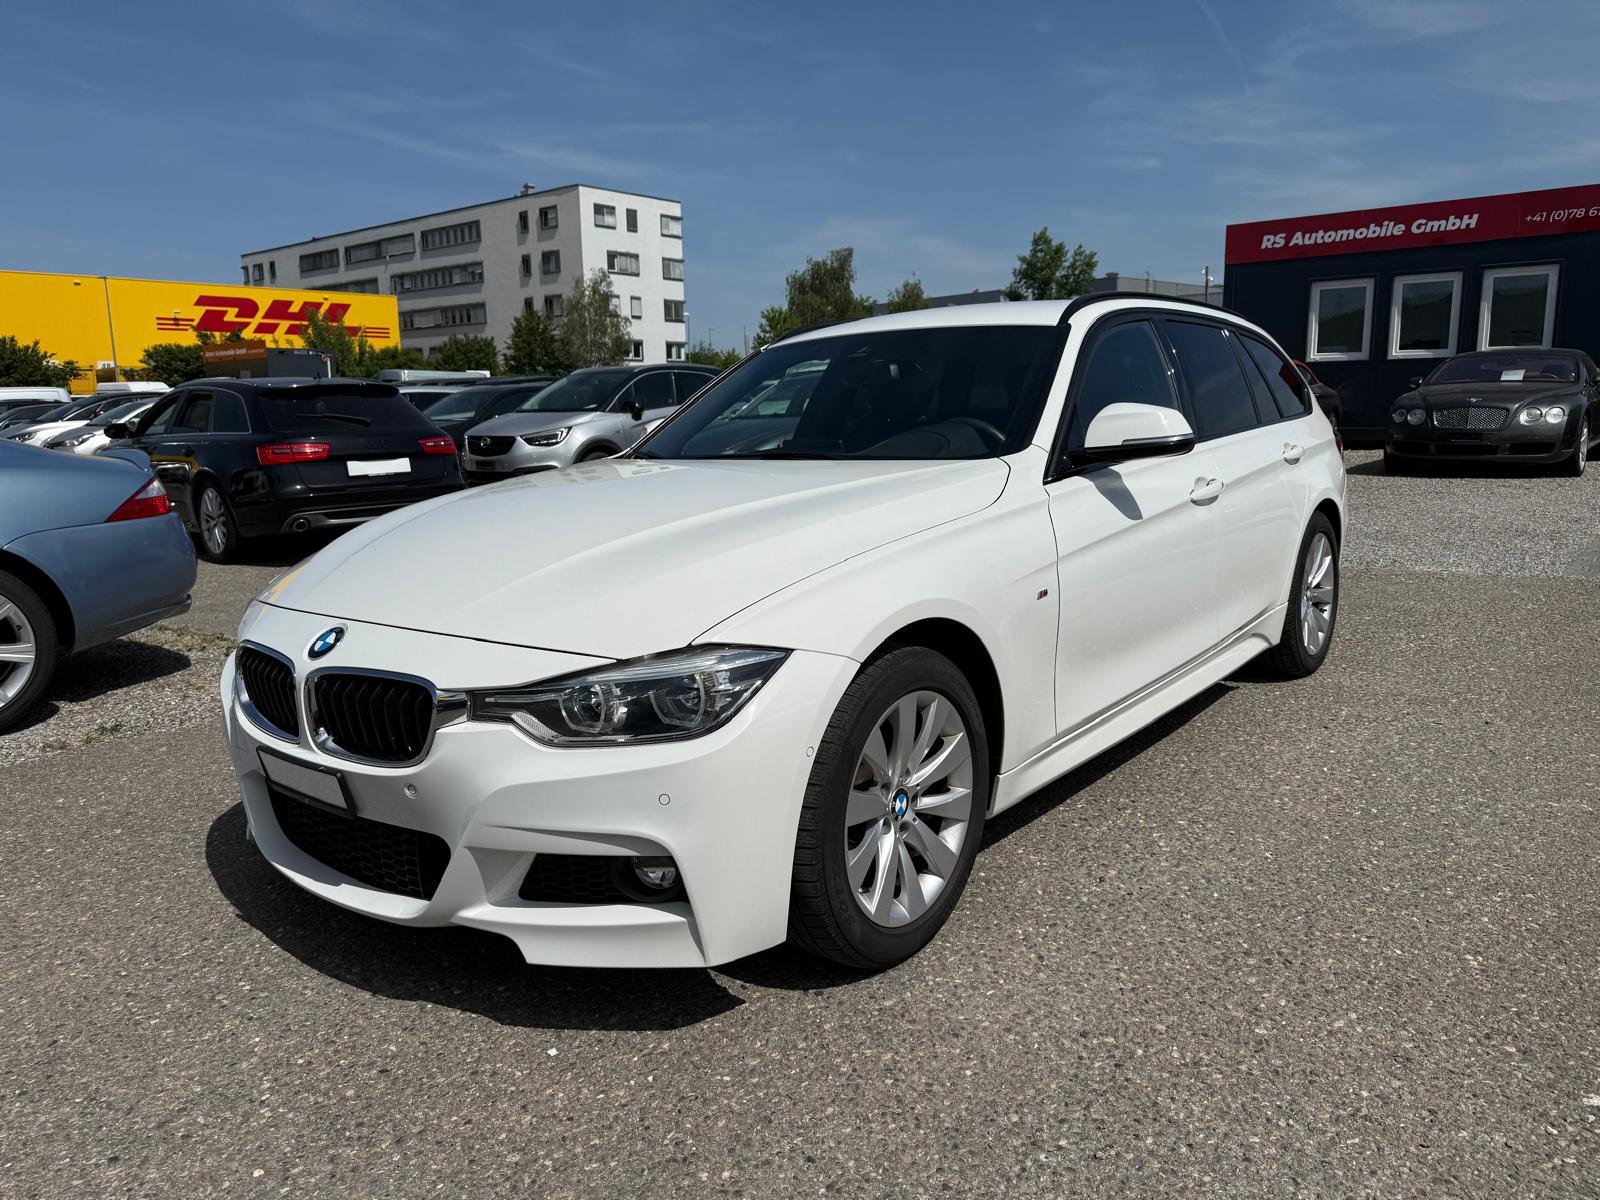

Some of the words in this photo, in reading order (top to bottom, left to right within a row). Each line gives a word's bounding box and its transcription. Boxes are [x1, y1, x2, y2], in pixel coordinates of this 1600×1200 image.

[1260, 233, 1287, 250] RS
[1289, 220, 1406, 247] Automobile
[1410, 213, 1480, 235] GmbH
[1525, 212, 1548, 222] +41
[1549, 207, 1586, 223] (0)78
[1588, 206, 1600, 217] 6
[193, 294, 362, 338] DHL
